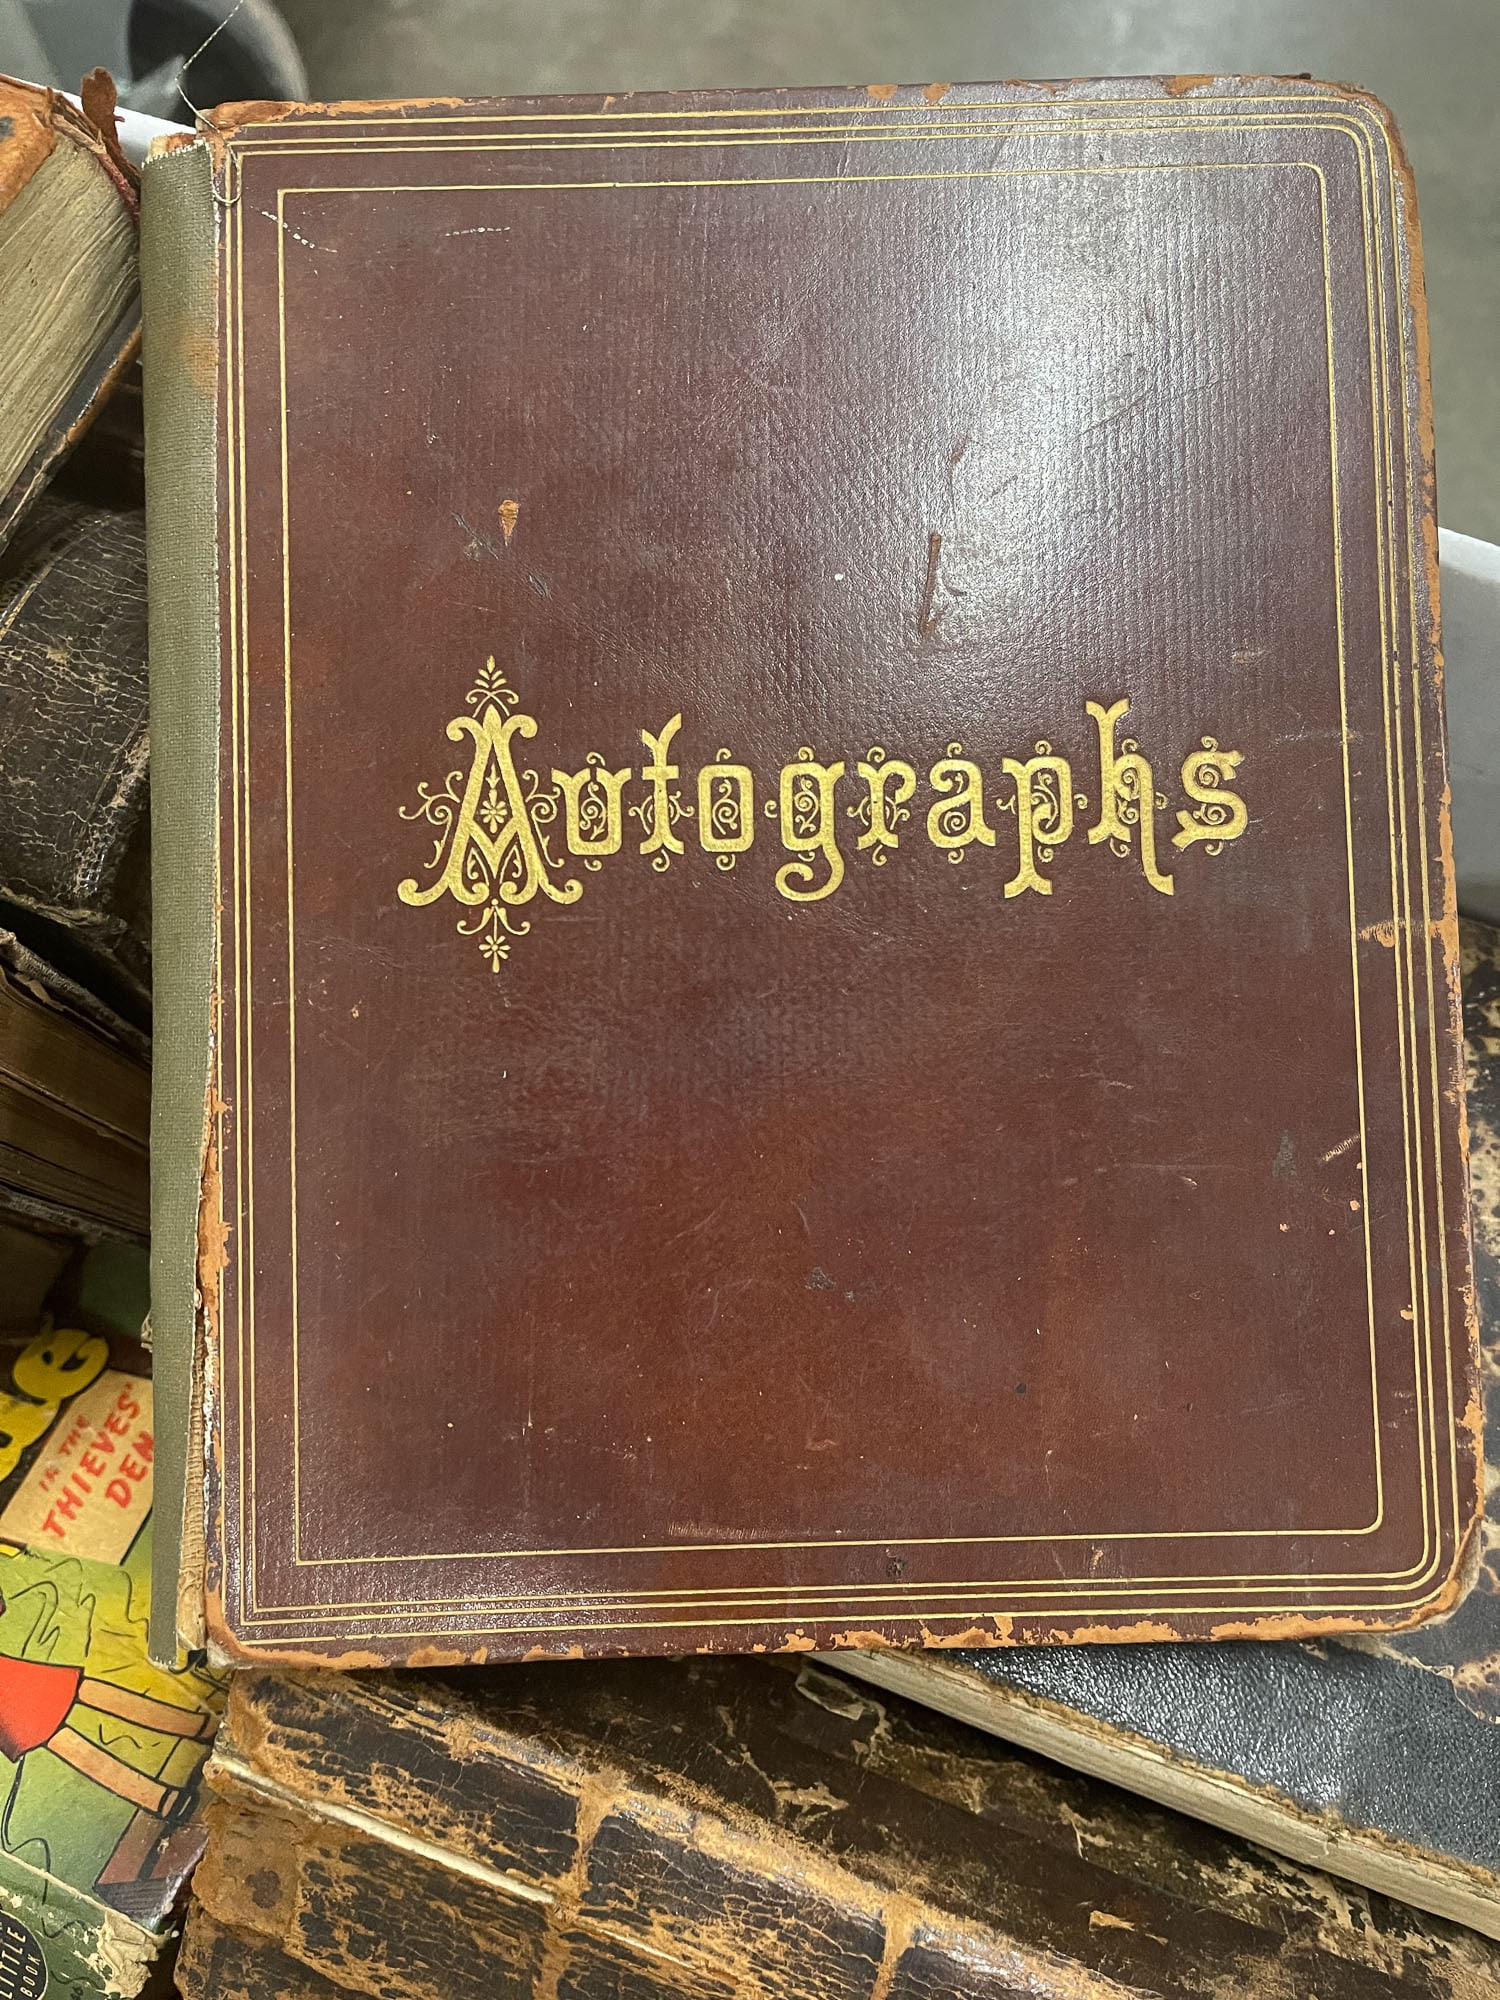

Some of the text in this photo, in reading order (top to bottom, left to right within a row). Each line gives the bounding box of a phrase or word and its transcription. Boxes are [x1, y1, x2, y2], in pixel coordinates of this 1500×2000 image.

[397, 697, 1249, 904] Autographs
[41, 1382, 140, 1538] THIEVES'
[105, 1431, 153, 1509] DEN
[0, 1926, 26, 1999] LITTLE
[20, 1953, 41, 1998] BOOK
